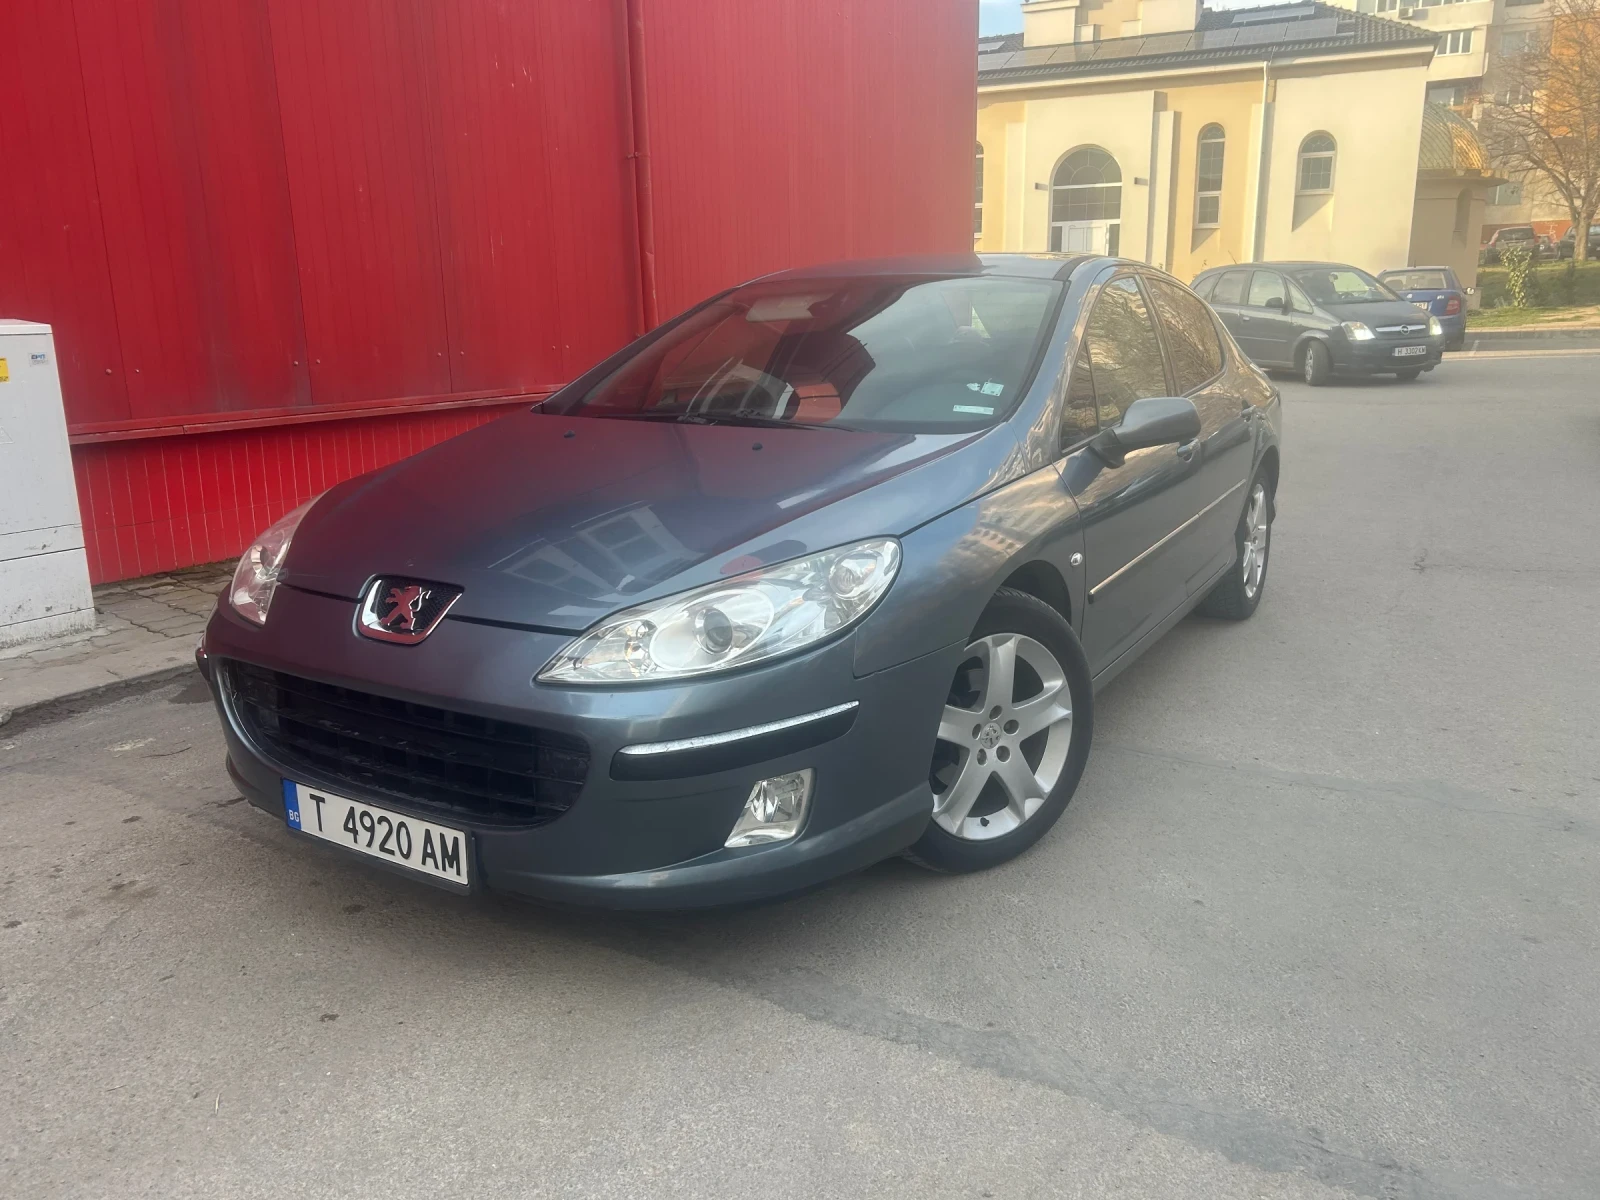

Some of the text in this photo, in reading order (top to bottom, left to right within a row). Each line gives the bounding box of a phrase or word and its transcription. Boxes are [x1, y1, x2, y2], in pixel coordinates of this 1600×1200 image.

[288, 809, 300, 823] BG
[309, 793, 461, 877] T 4920 AM
